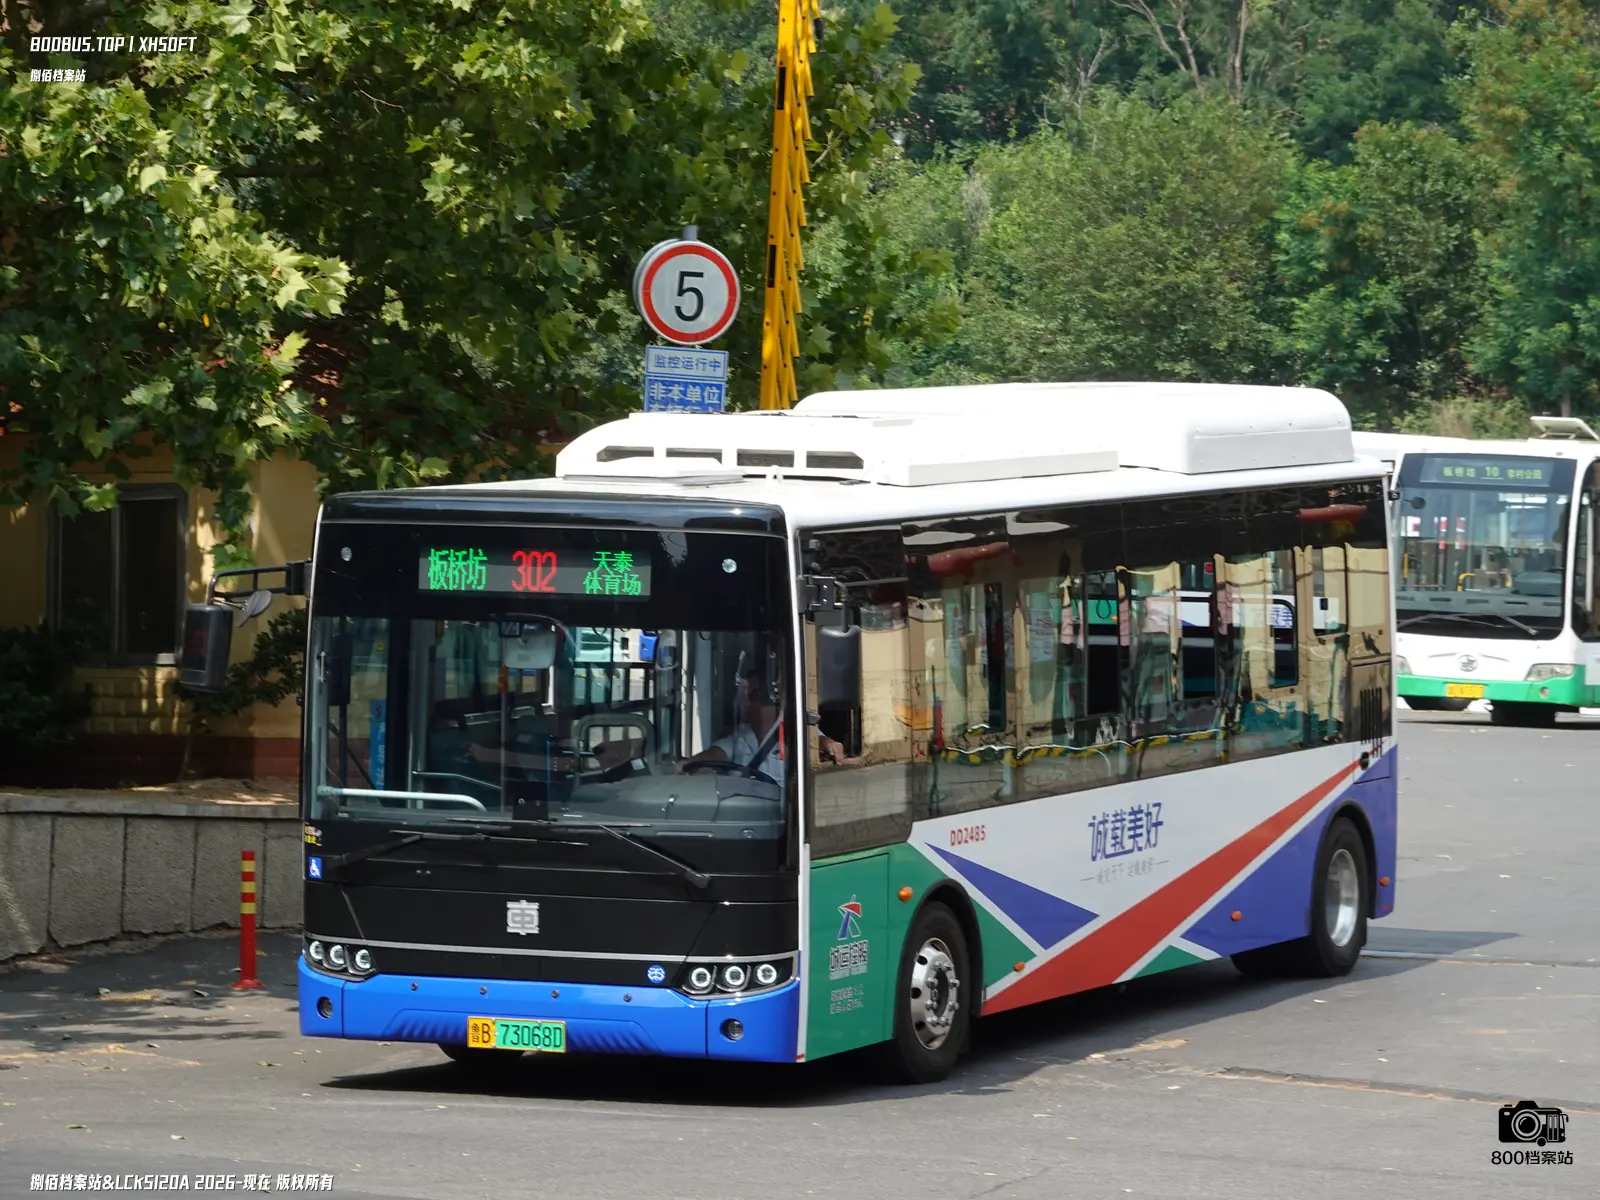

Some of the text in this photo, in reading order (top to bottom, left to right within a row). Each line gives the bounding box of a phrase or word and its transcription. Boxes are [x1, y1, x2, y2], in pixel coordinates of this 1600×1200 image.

[674, 271, 704, 322] 5
[653, 354, 722, 373] 监控运行中
[649, 382, 721, 404] 非本单位
[1485, 466, 1500, 477] 10
[428, 548, 557, 592] 板桥坊 302
[593, 551, 633, 574] 天泰
[583, 571, 642, 596] 体育场
[950, 824, 986, 847] DD2485
[1088, 801, 1163, 862] 诚载美好
